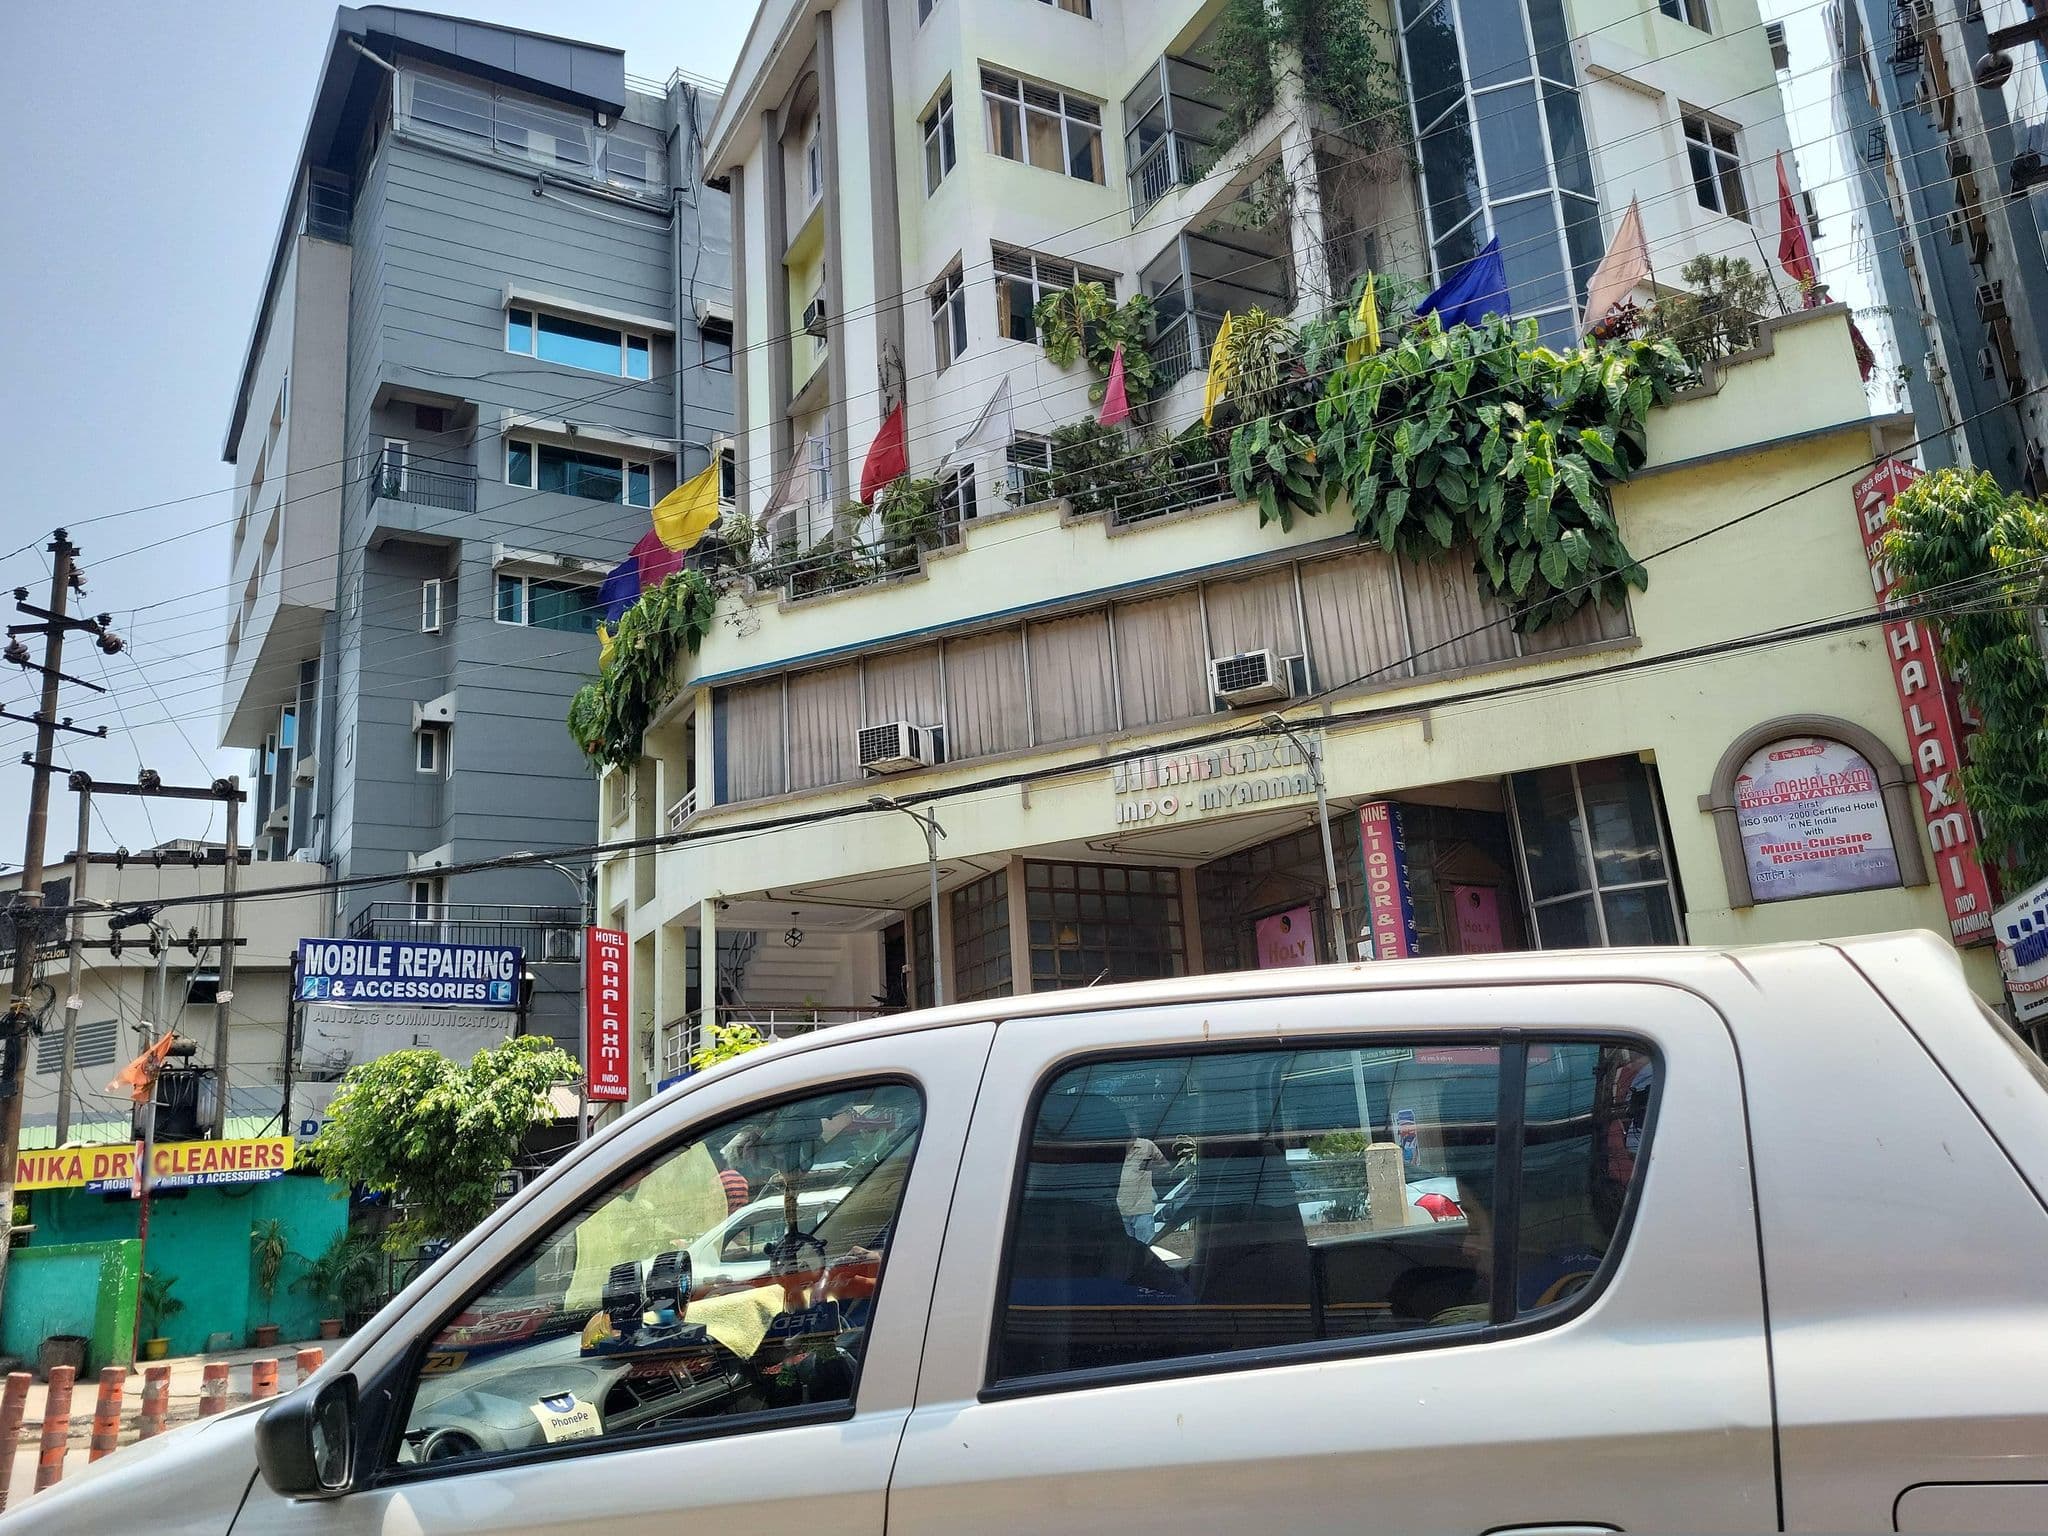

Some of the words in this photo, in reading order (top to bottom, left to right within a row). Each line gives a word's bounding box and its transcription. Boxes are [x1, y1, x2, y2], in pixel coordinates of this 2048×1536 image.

[1775, 769, 1870, 794] MAHALAXMI
[1744, 783, 1870, 808] INDO-MYANMAR
[1798, 801, 1819, 809] First
[1116, 795, 1179, 824] INDO
[1360, 805, 1387, 824] WINE
[1744, 817, 1761, 827] ISO
[1789, 811, 1810, 821] 2000
[1812, 805, 1851, 818] Certified
[1854, 801, 1878, 812] Hotel
[1788, 822, 1797, 830] in
[1798, 820, 1812, 828] NE
[1815, 817, 1837, 826] India
[1804, 828, 1824, 836] with
[1760, 832, 1873, 855] Multi-Cuisine
[1772, 844, 1865, 864] Restaurant
[1367, 825, 1392, 907] LIQUOR
[1954, 893, 1976, 914] INDO
[1377, 913, 1395, 926] &
[1951, 911, 1991, 937] MYANMAR
[595, 931, 625, 946] HOTEL
[1269, 940, 1306, 963] HOLY
[304, 944, 393, 976] MOBILE
[398, 947, 513, 981] REPAIRING
[331, 980, 346, 997] &
[352, 981, 486, 999] ACCESSORIES
[601, 946, 620, 1072] MAHALAXMI
[384, 1012, 510, 1029] COMMUNICATION
[601, 1073, 619, 1083] INDO
[593, 1084, 627, 1096] MYANMAR
[153, 1143, 285, 1175] CLEANERS
[198, 1174, 204, 1184] &
[206, 1170, 271, 1182] ACCESSORIES
[551, 1412, 589, 1429] PhonePe
